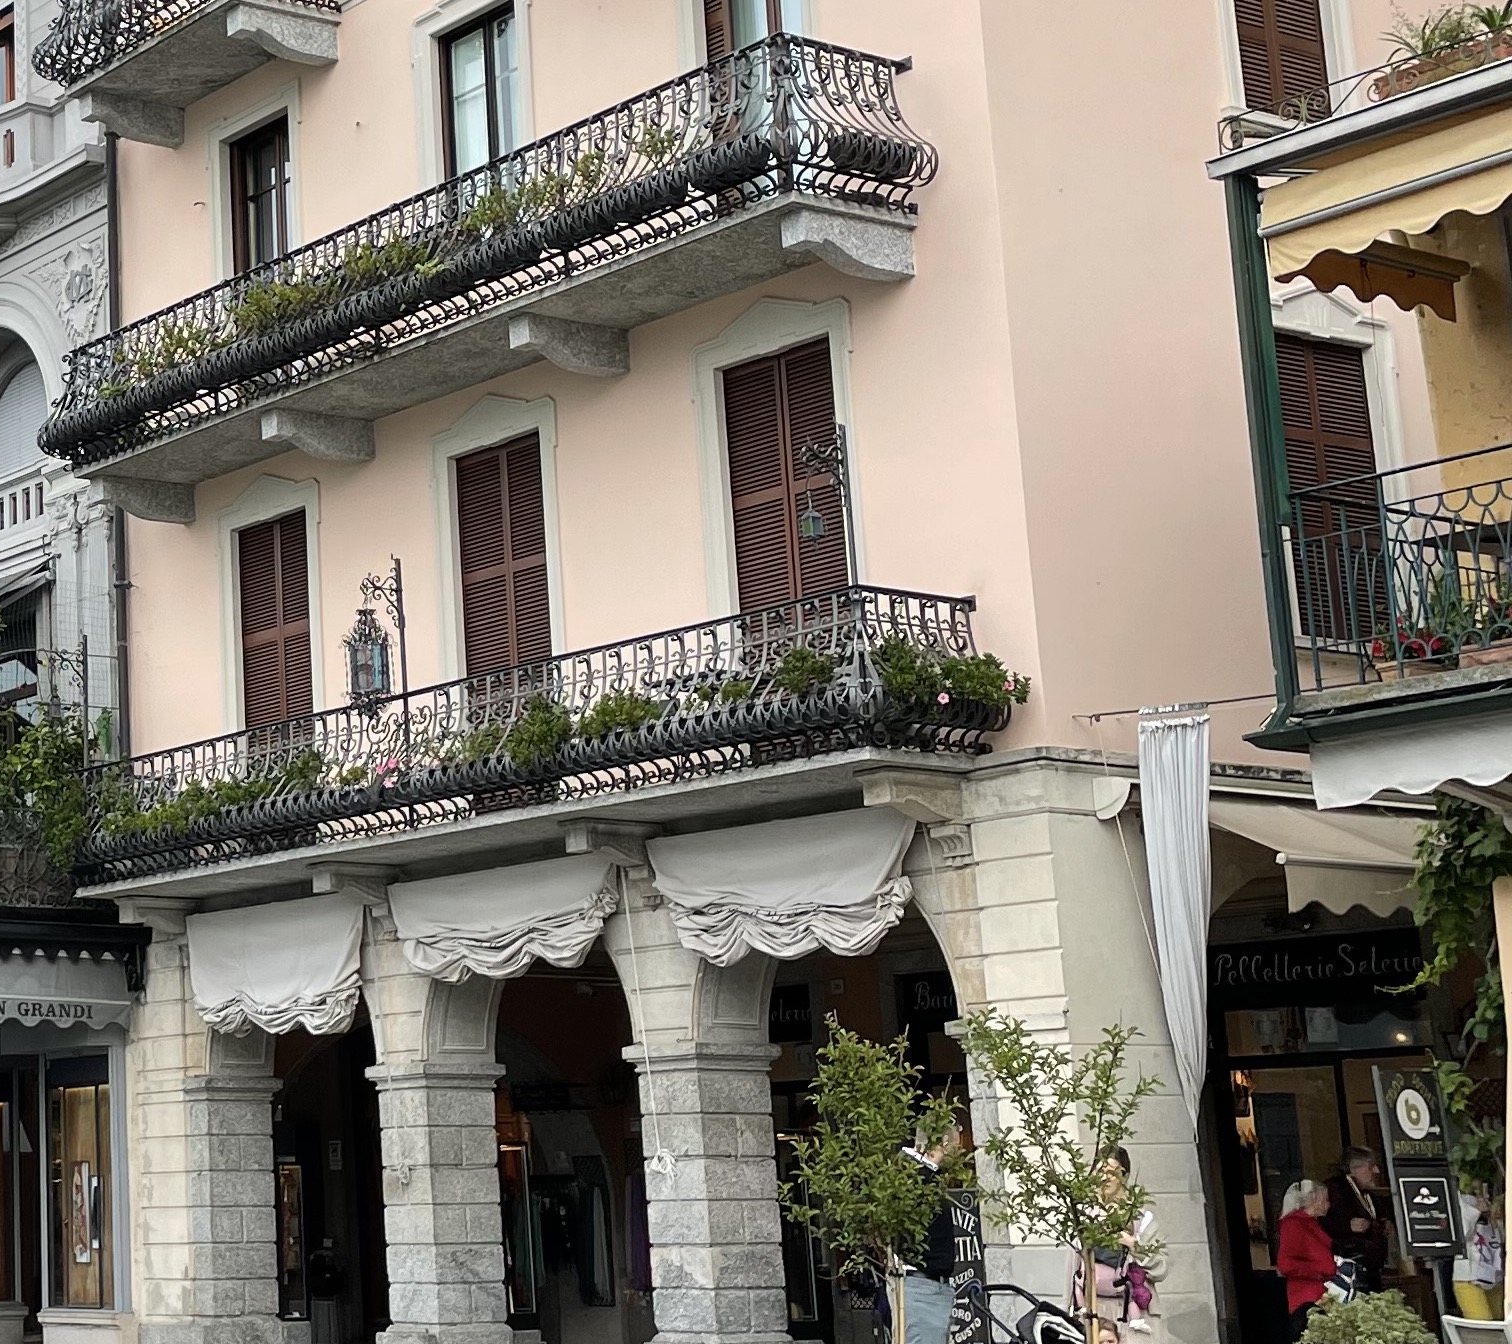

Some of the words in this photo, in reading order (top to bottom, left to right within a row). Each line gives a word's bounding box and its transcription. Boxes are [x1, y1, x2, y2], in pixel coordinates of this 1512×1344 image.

[17, 1002, 93, 1019] GRANDI
[954, 1236, 982, 1262] TTA
[949, 1268, 974, 1287] RAZZO
[955, 1317, 981, 1343] GUSTO
